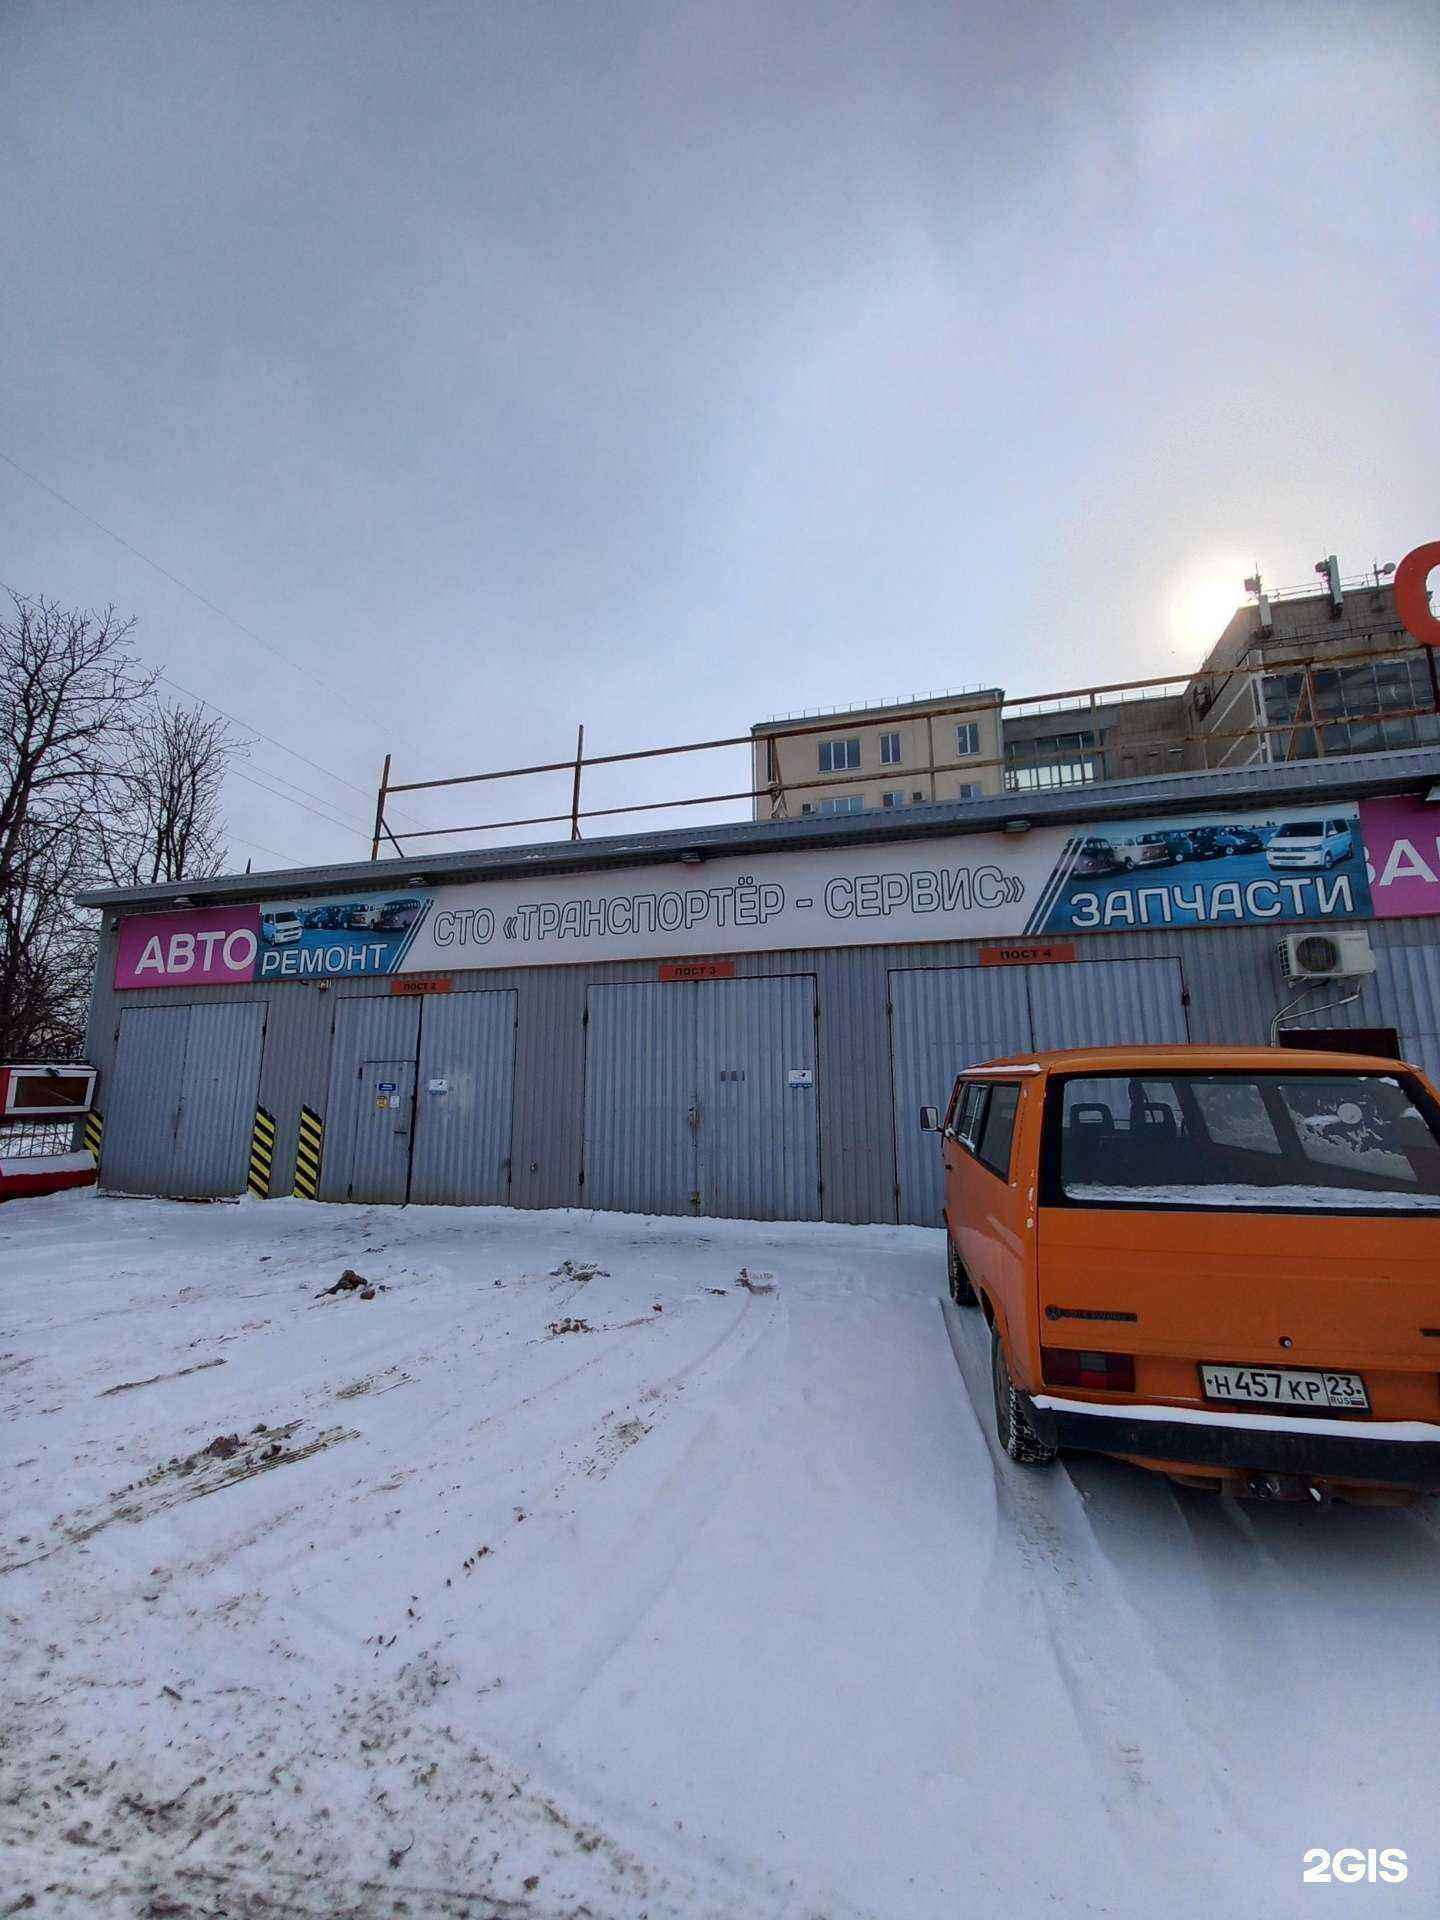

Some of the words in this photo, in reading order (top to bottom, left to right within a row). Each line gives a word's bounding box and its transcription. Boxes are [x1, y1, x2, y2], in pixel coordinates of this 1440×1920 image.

[433, 907, 495, 947] СТО
[502, 876, 786, 941] «ТРАНСПОРТЁР
[824, 865, 1025, 919] СЕРВИС»
[1070, 874, 1354, 928] ЗАПЧАСТИ
[135, 928, 257, 976] АВТО
[261, 942, 389, 976] РЕМОНТ
[1000, 949, 1040, 960] ПОСТ
[675, 966, 706, 976] ПОСТ
[403, 982, 428, 991] ПОСТ
[1330, 1397, 1350, 1406] RUS
